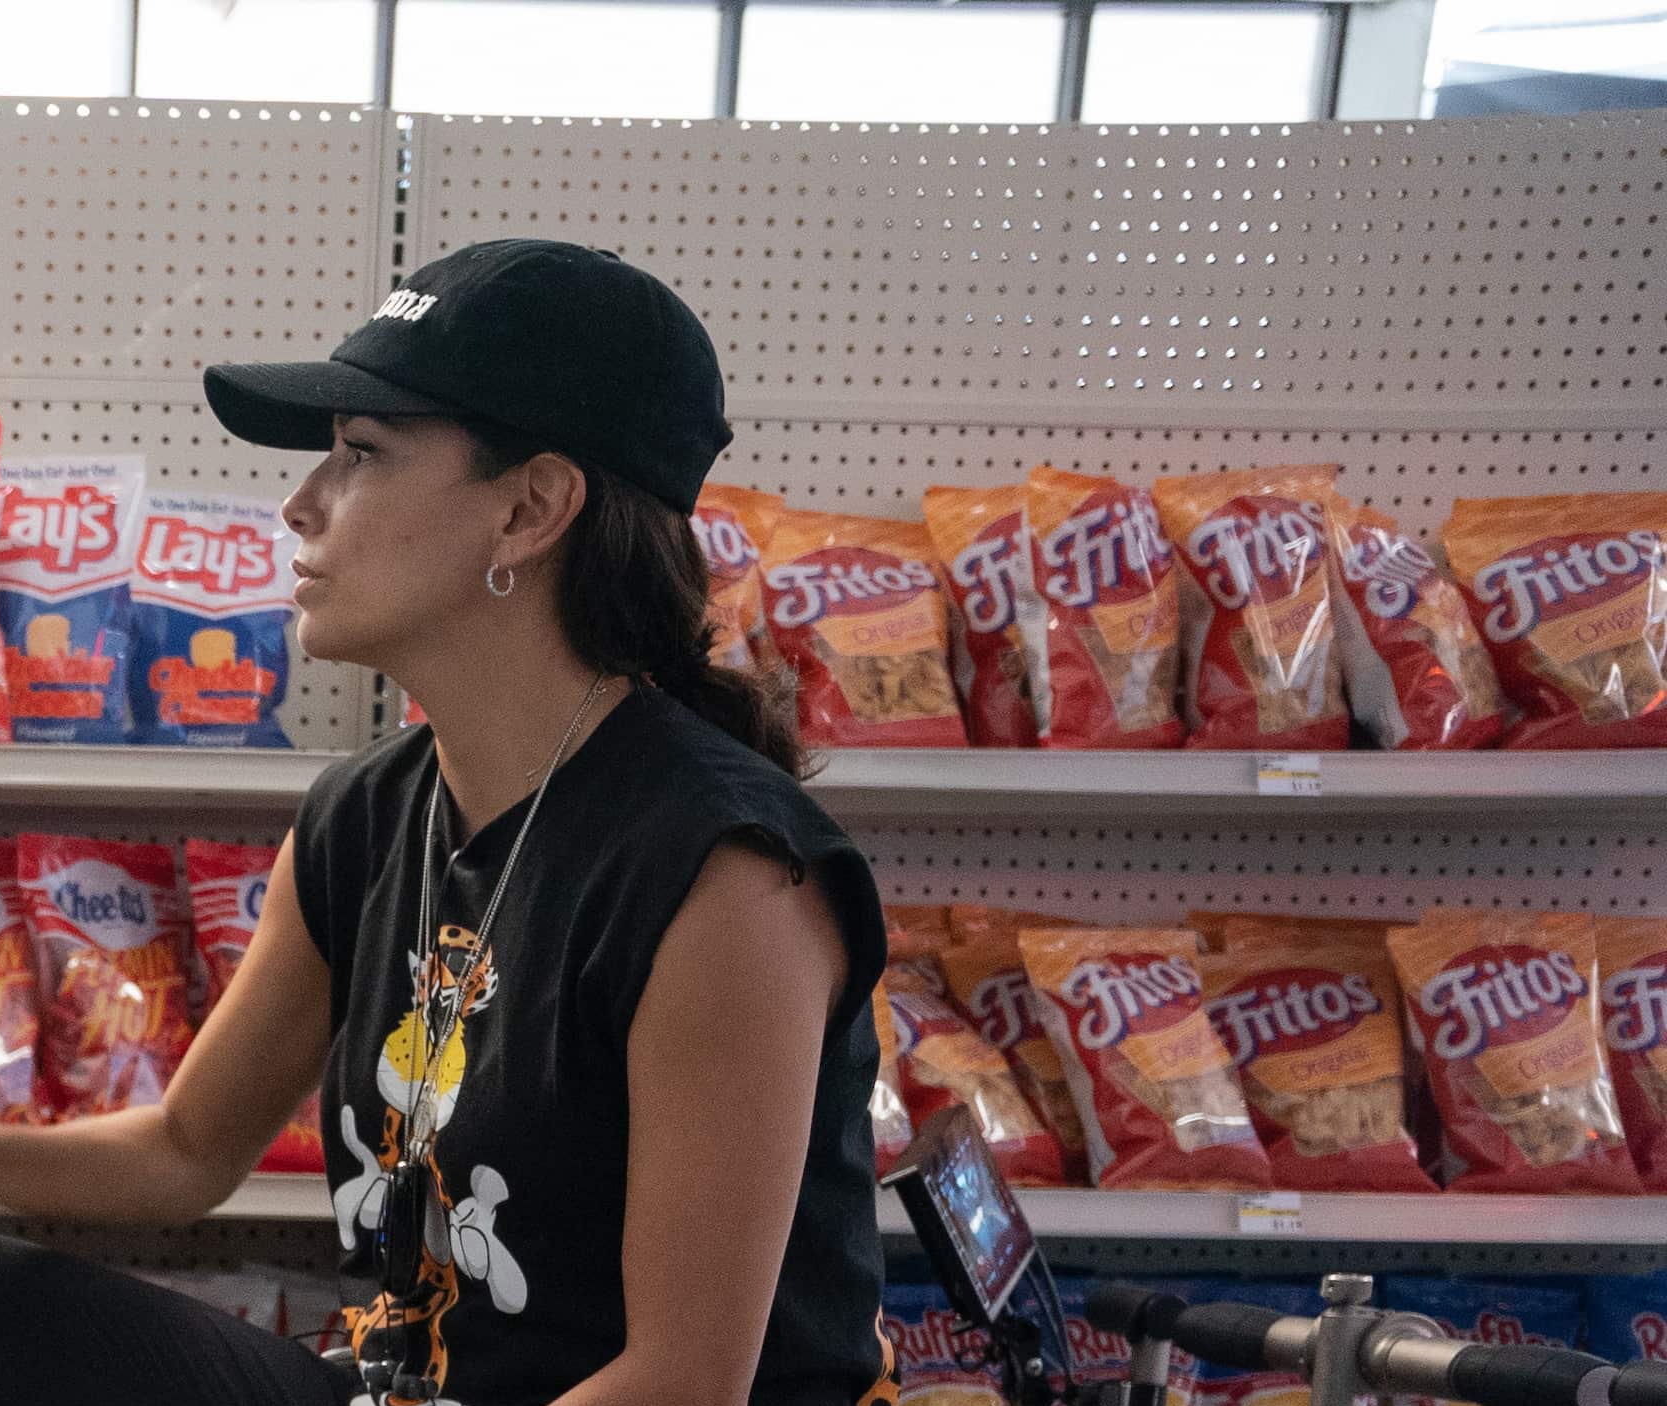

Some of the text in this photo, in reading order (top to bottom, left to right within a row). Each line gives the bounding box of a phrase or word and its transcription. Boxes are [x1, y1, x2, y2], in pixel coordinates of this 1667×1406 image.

[141, 520, 266, 590] Lay's
[767, 557, 938, 630] Fritos
[1474, 529, 1661, 643] Fritos
[1209, 972, 1377, 1065] Fritos
[1422, 950, 1587, 1060] Fritos
